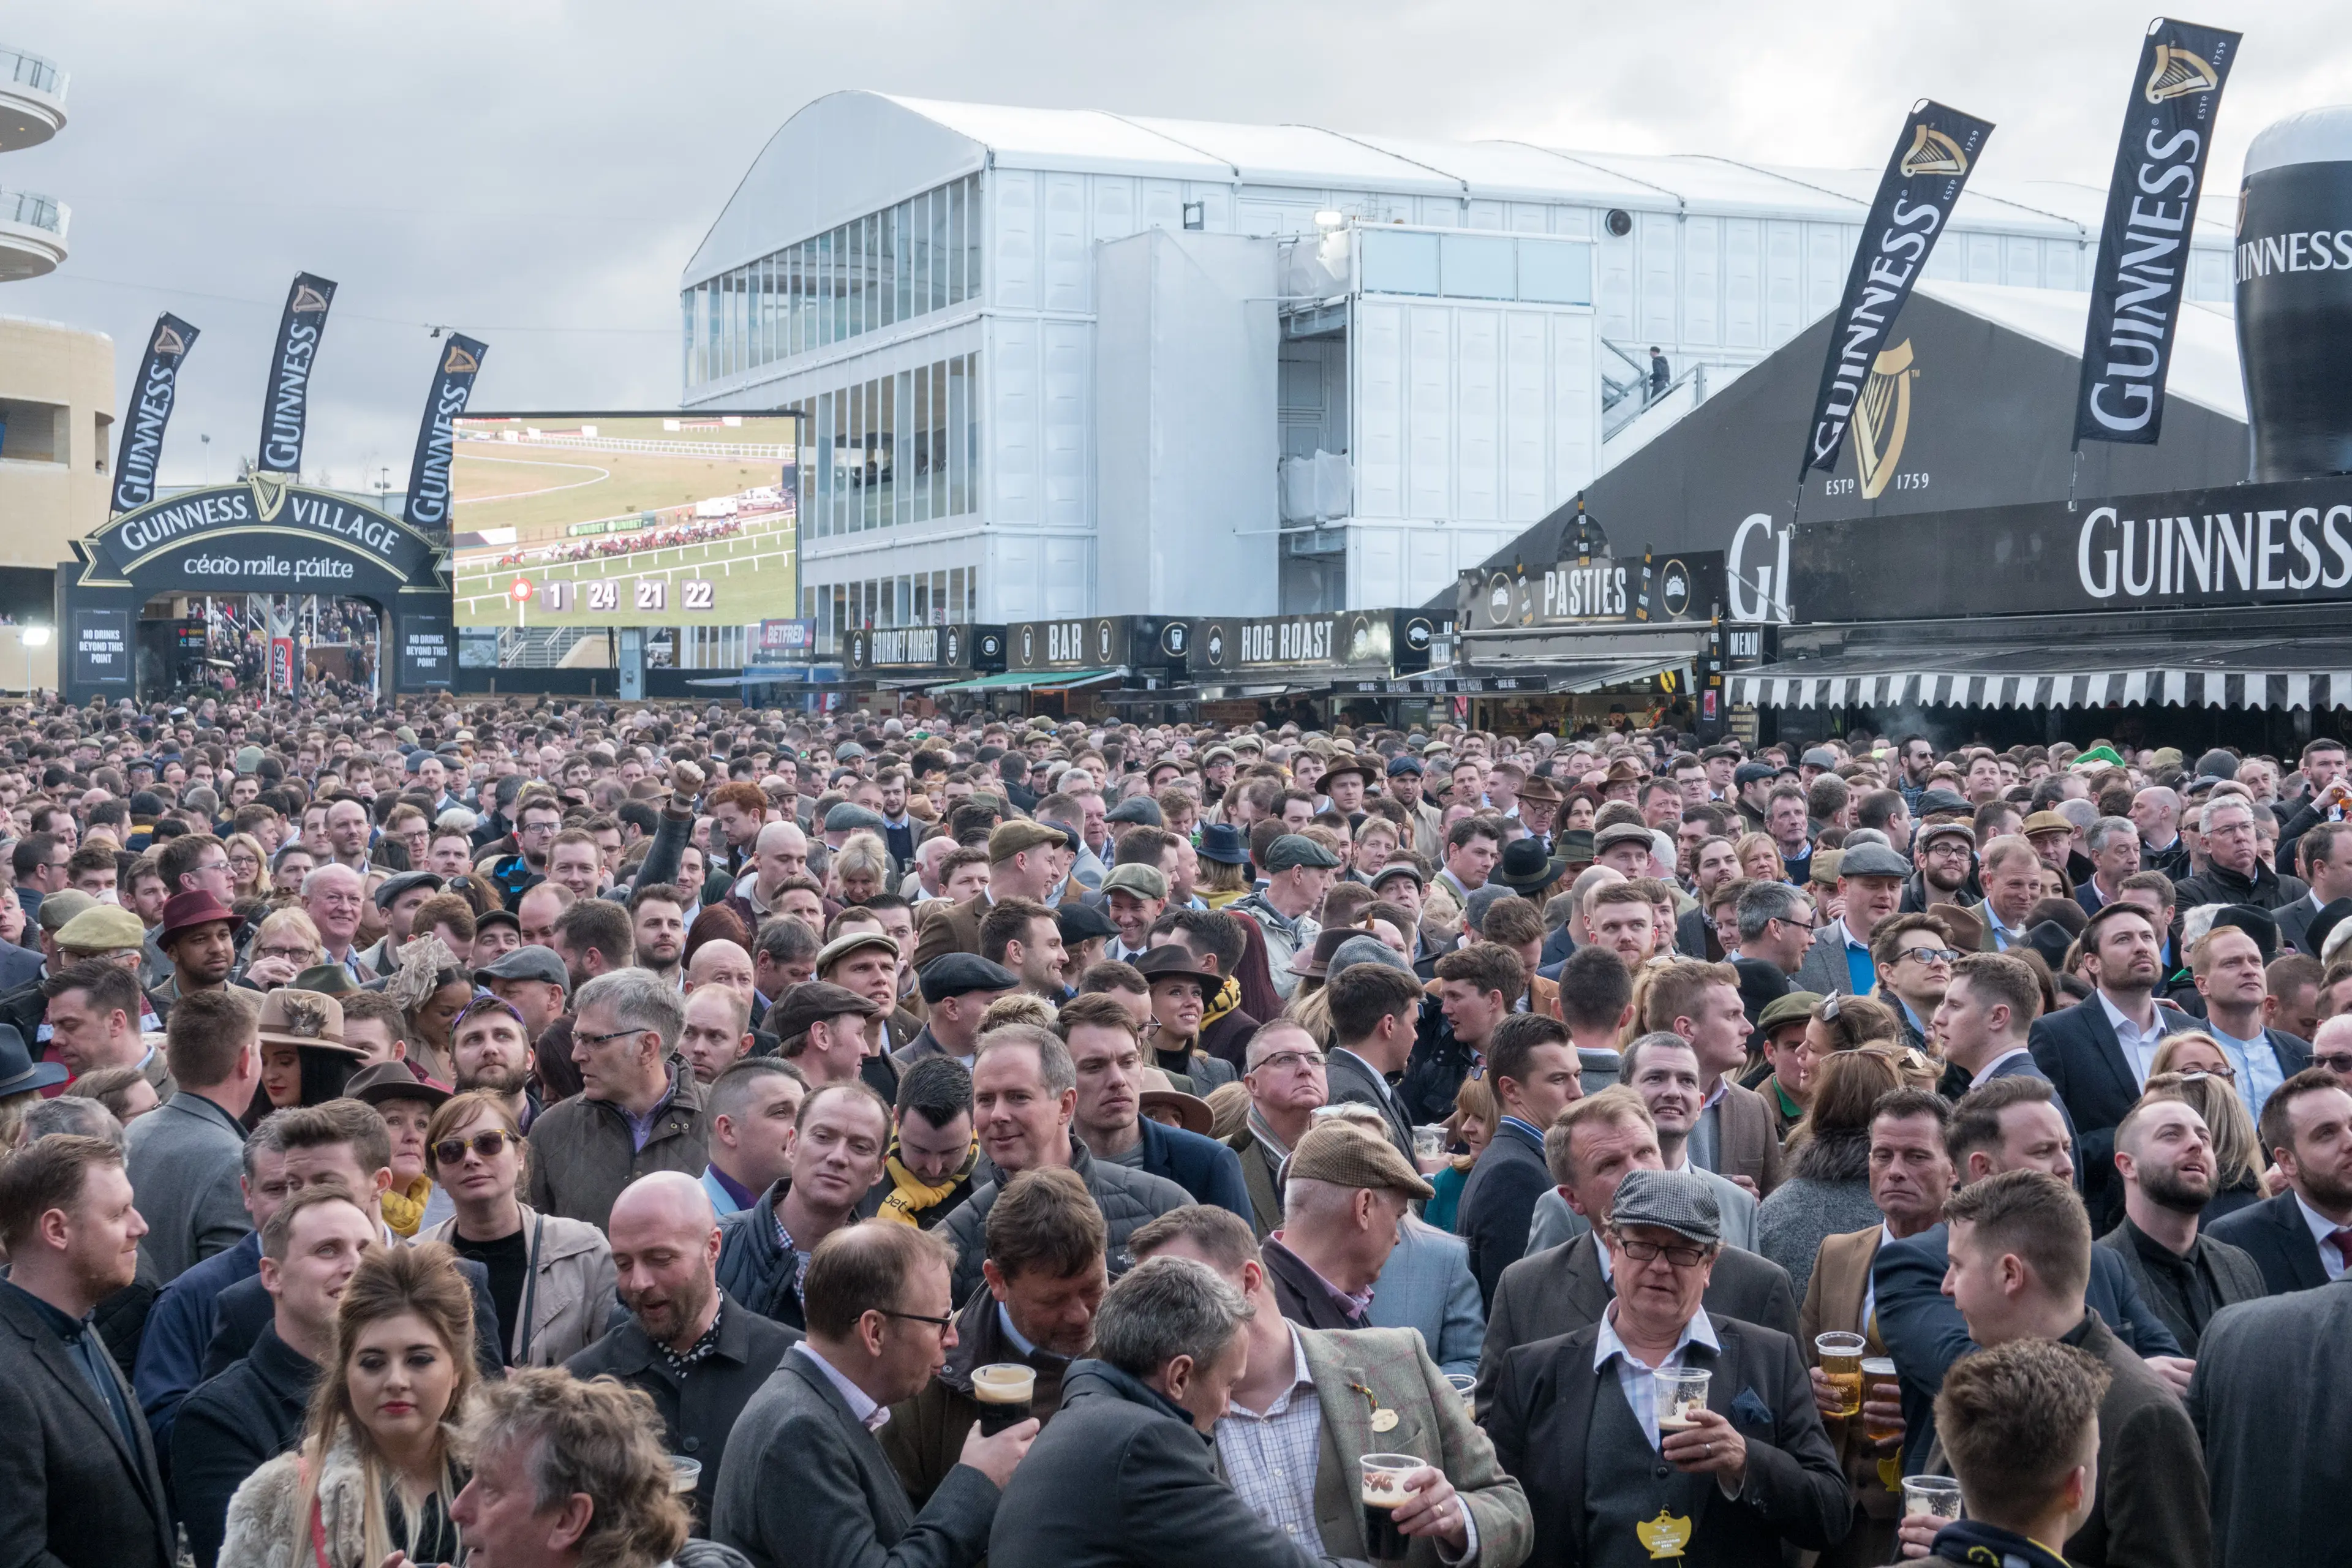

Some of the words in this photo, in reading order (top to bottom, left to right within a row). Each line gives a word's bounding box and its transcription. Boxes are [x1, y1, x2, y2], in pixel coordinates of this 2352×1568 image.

[2213, 42, 2226, 65] 1759
[1965, 130, 1979, 151] 1759
[2234, 230, 2352, 285] UINNESS
[2090, 128, 2200, 431] GUINNESS
[1811, 198, 1940, 466] GUINNESS
[265, 323, 317, 468] GUINNESS
[117, 364, 175, 510] GUINNESS
[412, 383, 467, 522] GUINNESS
[1826, 478, 1855, 496] ESTD
[1898, 473, 1929, 490] 1759
[121, 496, 246, 551] GUINNESS
[292, 497, 400, 555] VILLAGE
[578, 522, 605, 535] UNIBET
[616, 519, 643, 530] UNIBET
[2078, 505, 2352, 598] GUINNESS
[550, 583, 560, 608] 1
[590, 582, 616, 608] 24
[638, 583, 663, 608] 21
[686, 582, 712, 608] 22
[1544, 567, 1626, 616] PASTIES
[83, 630, 92, 639] NO
[94, 630, 120, 639] DRINKS
[410, 635, 419, 644] NO
[420, 635, 444, 644] DRINKS
[767, 625, 804, 644] BETFRED
[1049, 623, 1082, 661] BAR
[1242, 624, 1273, 662] HOG
[1280, 621, 1333, 660] ROAST
[1730, 632, 1758, 655] MENU
[79, 642, 107, 652] BEYOND
[107, 642, 124, 652] THIS
[406, 646, 431, 655] BEYOND
[432, 646, 448, 656] THIS
[872, 630, 907, 664] GOURMET
[908, 629, 938, 662] BURGER
[1431, 643, 1450, 663] MENU
[91, 654, 112, 663] POINT
[417, 657, 437, 668] POINT
[1467, 679, 1483, 692] PASTIES
